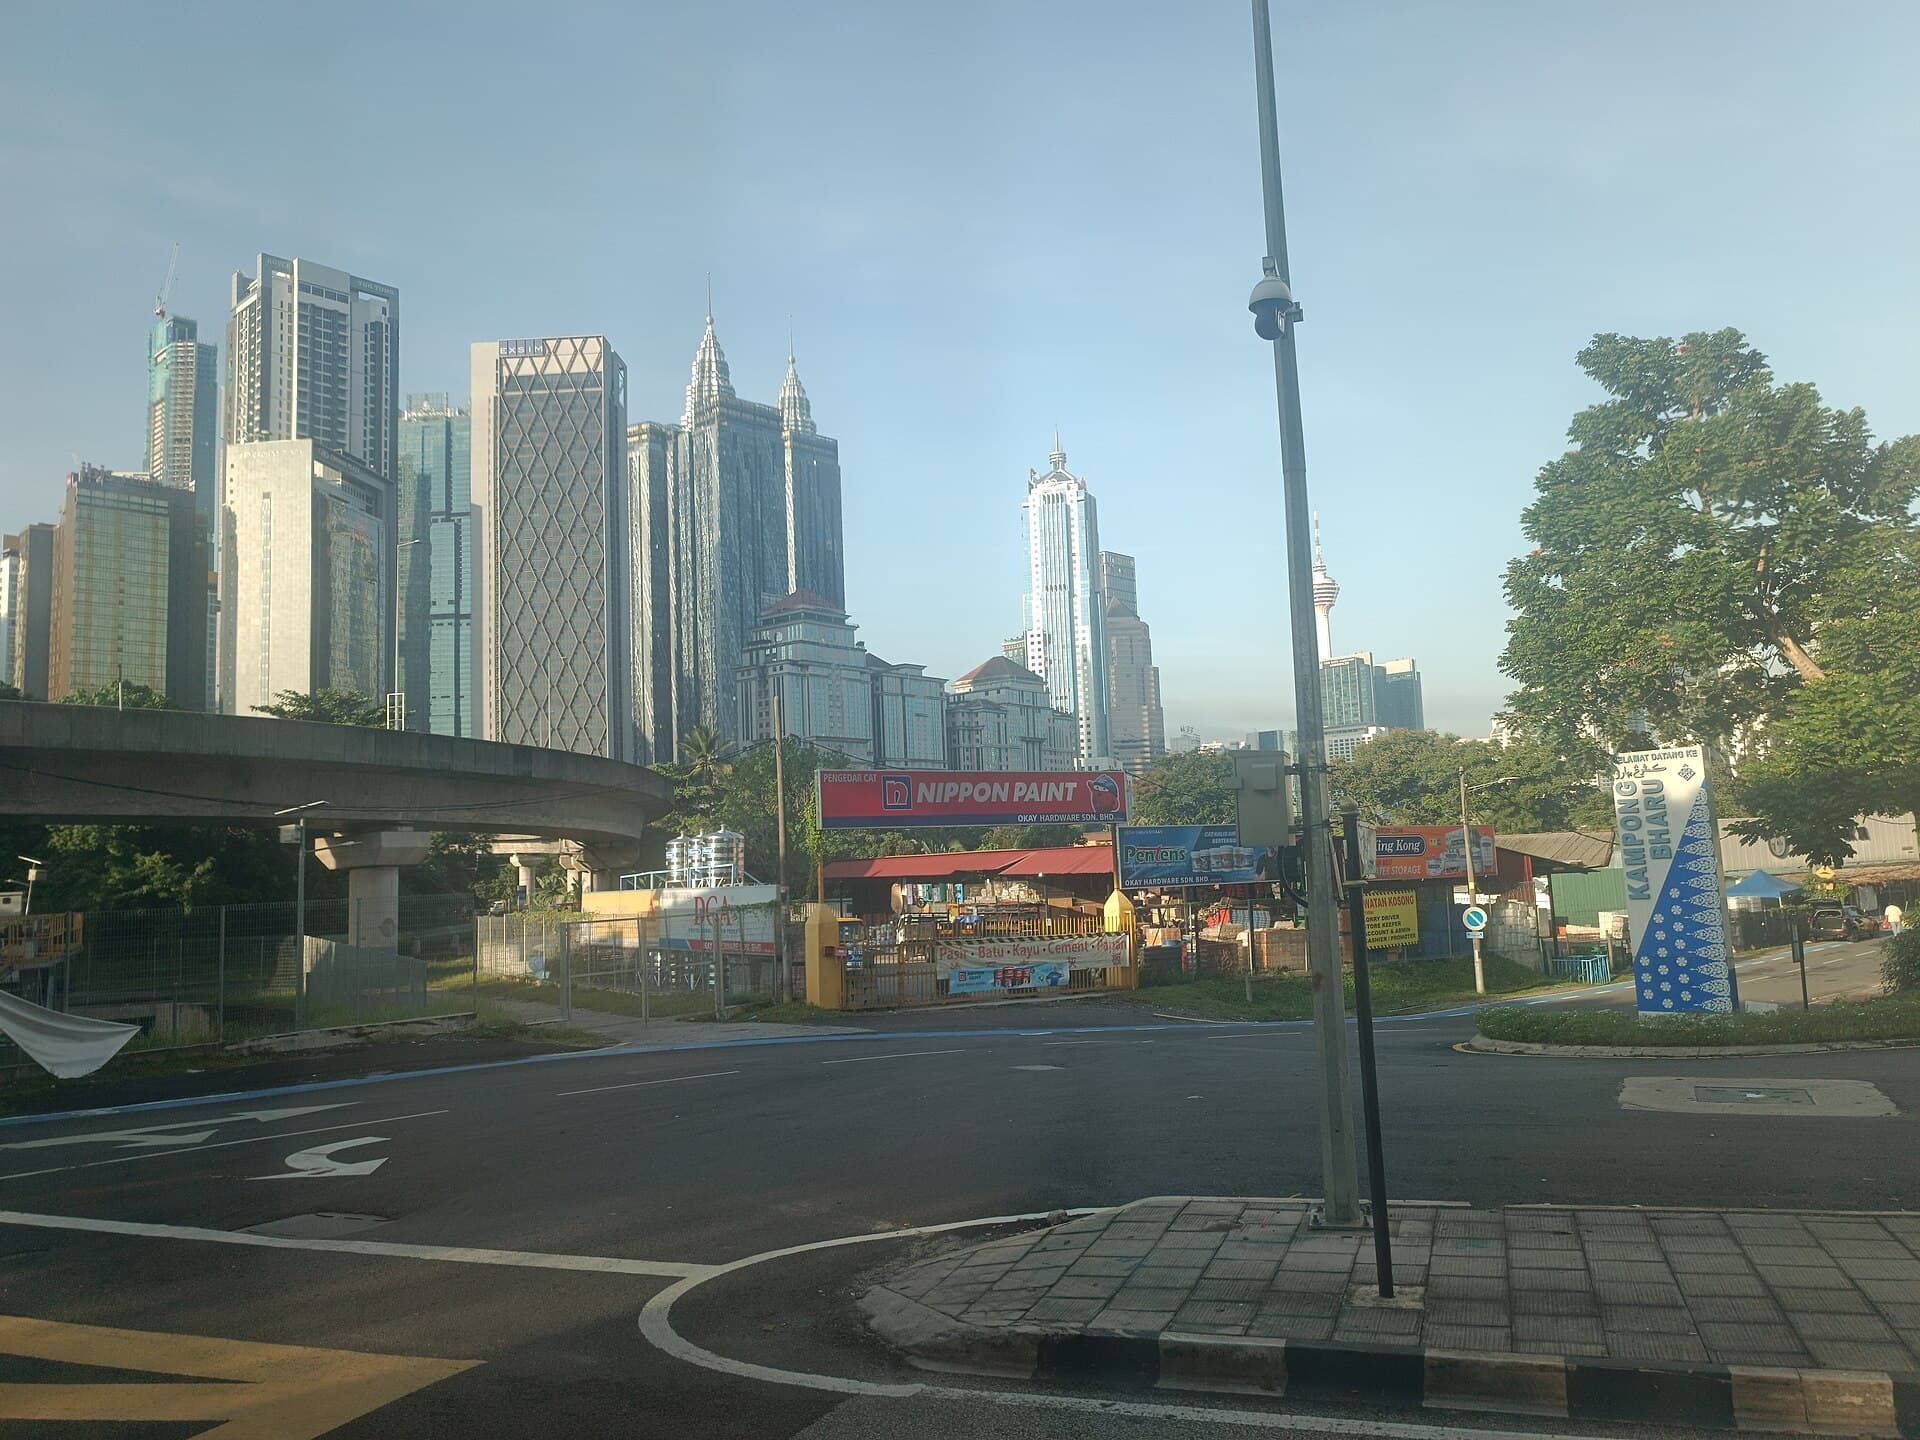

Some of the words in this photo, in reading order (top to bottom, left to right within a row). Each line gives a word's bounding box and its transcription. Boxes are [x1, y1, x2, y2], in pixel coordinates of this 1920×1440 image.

[500, 344, 543, 355] EXSIM
[1651, 751, 1684, 761] DATANG
[1686, 749, 1698, 758] KE
[823, 773, 861, 783] PENGEDAR
[864, 773, 877, 783] CAT
[916, 782, 1009, 803] NIPPON
[1013, 782, 1077, 802] PAINT
[1018, 814, 1037, 822] OKAY
[1039, 814, 1080, 822] HARDWARE
[1100, 813, 1114, 821] BHD
[1641, 779, 1672, 860] BHARU
[1396, 839, 1421, 853] Kong
[1616, 780, 1651, 900] KAMPONG
[1124, 845, 1187, 864] Pentens
[1391, 865, 1421, 876] STORAGE
[1124, 879, 1143, 887] OKAY
[1388, 896, 1414, 906] KOSONG
[978, 946, 1004, 958] Batu
[1013, 943, 1040, 958] Kayu
[1048, 941, 1089, 954] Cement
